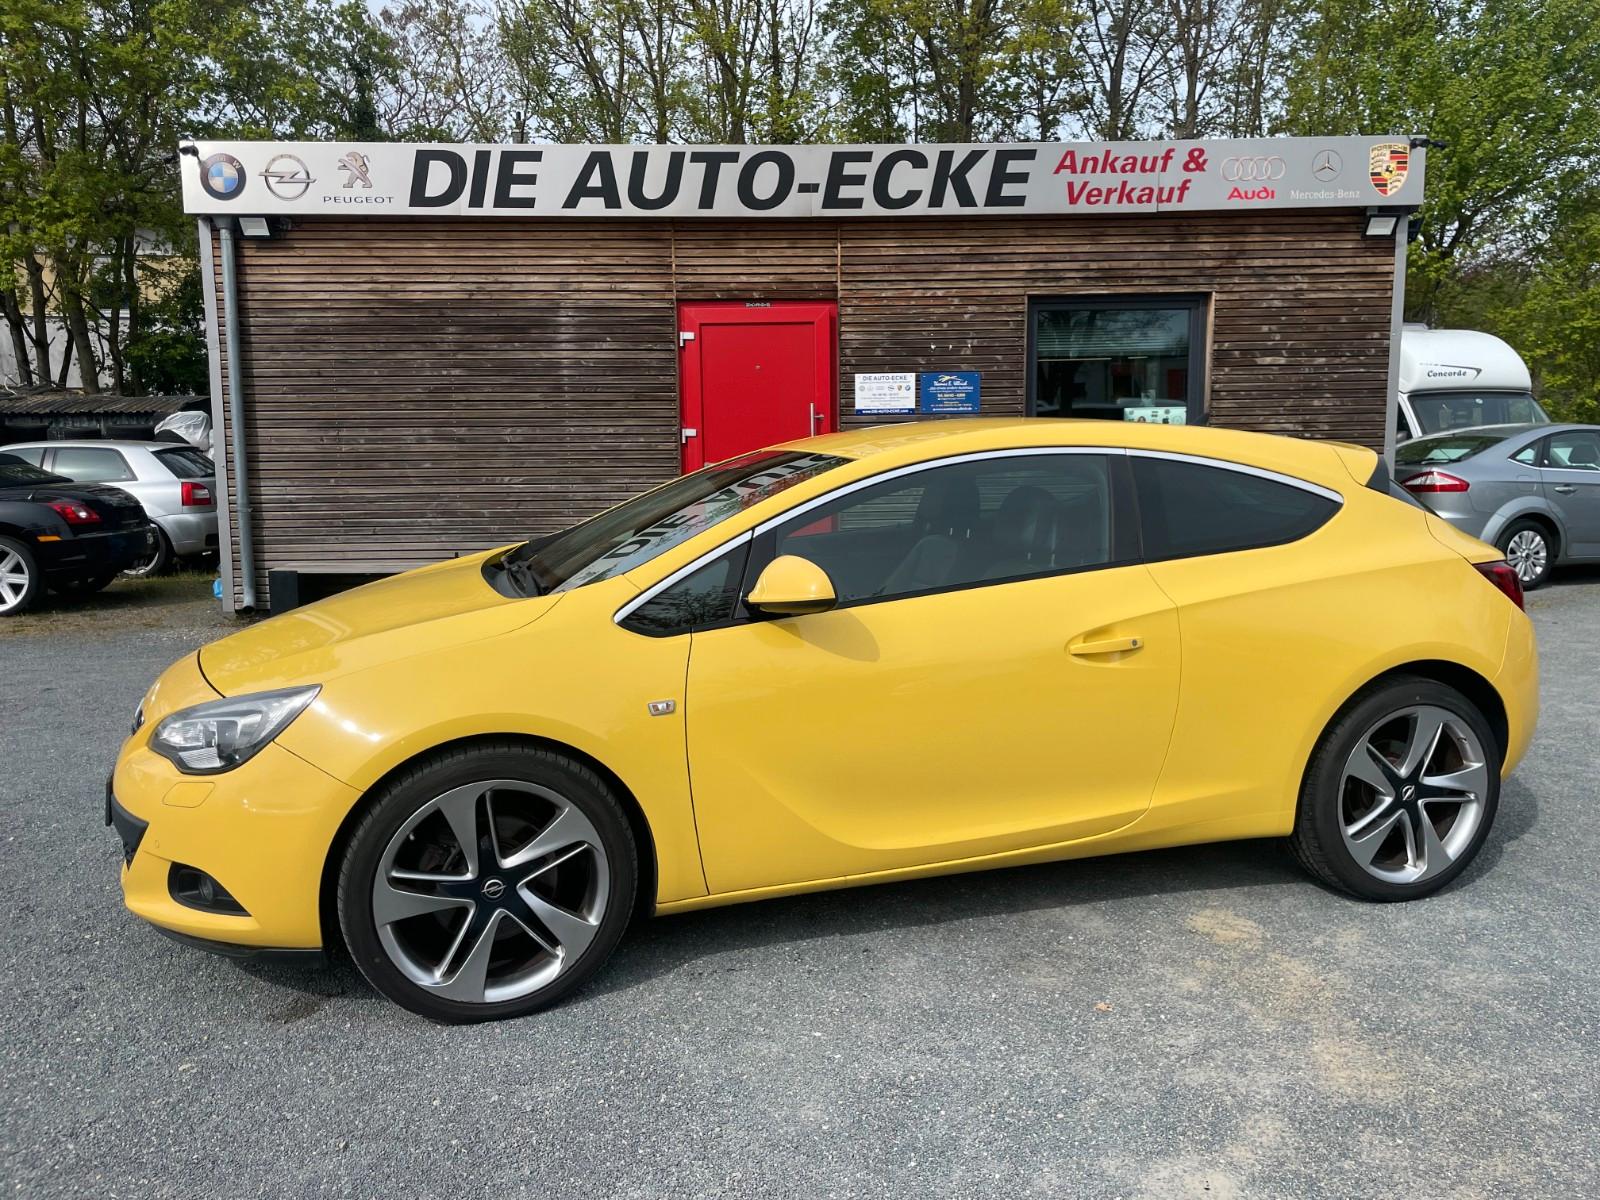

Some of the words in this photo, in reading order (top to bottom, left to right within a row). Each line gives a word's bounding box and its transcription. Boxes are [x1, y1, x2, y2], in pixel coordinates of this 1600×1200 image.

[1371, 144, 1408, 153] PORSCHE
[1053, 148, 1175, 175] Ankauf
[1182, 147, 1208, 173] &
[408, 149, 544, 208] DIE
[561, 148, 1038, 211] AUTO-ECKE
[323, 196, 394, 204] PEUGEOT
[1066, 179, 1192, 206] Verkauf
[1227, 186, 1276, 201] Audi
[1290, 189, 1360, 200] Mercedes-Benz
